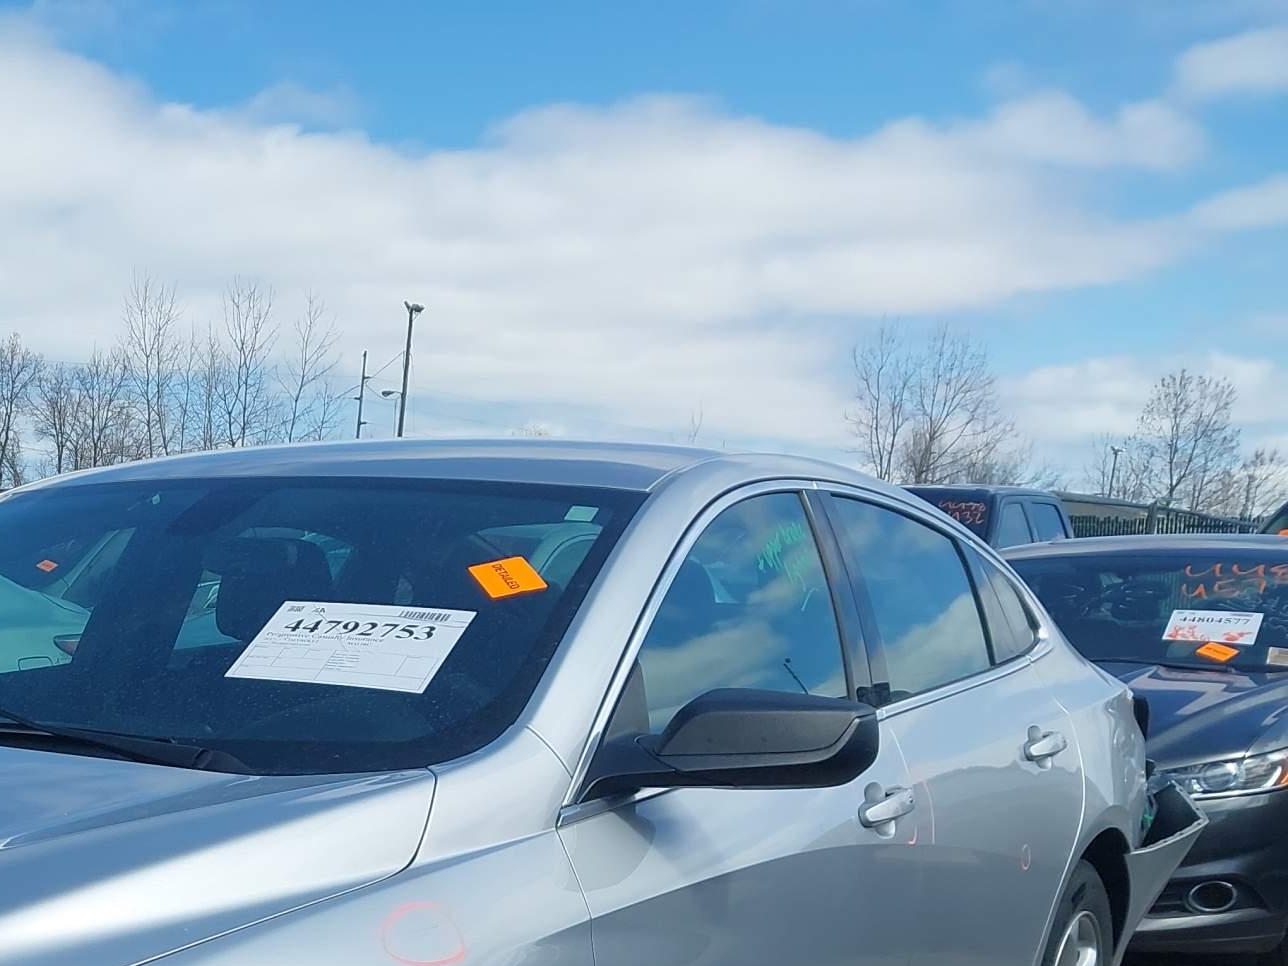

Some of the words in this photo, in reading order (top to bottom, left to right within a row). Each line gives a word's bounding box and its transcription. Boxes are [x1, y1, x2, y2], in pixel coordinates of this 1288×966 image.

[492, 563, 521, 589] DETAILED
[284, 618, 436, 640] 44792753
[1179, 616, 1252, 625] 44804577
